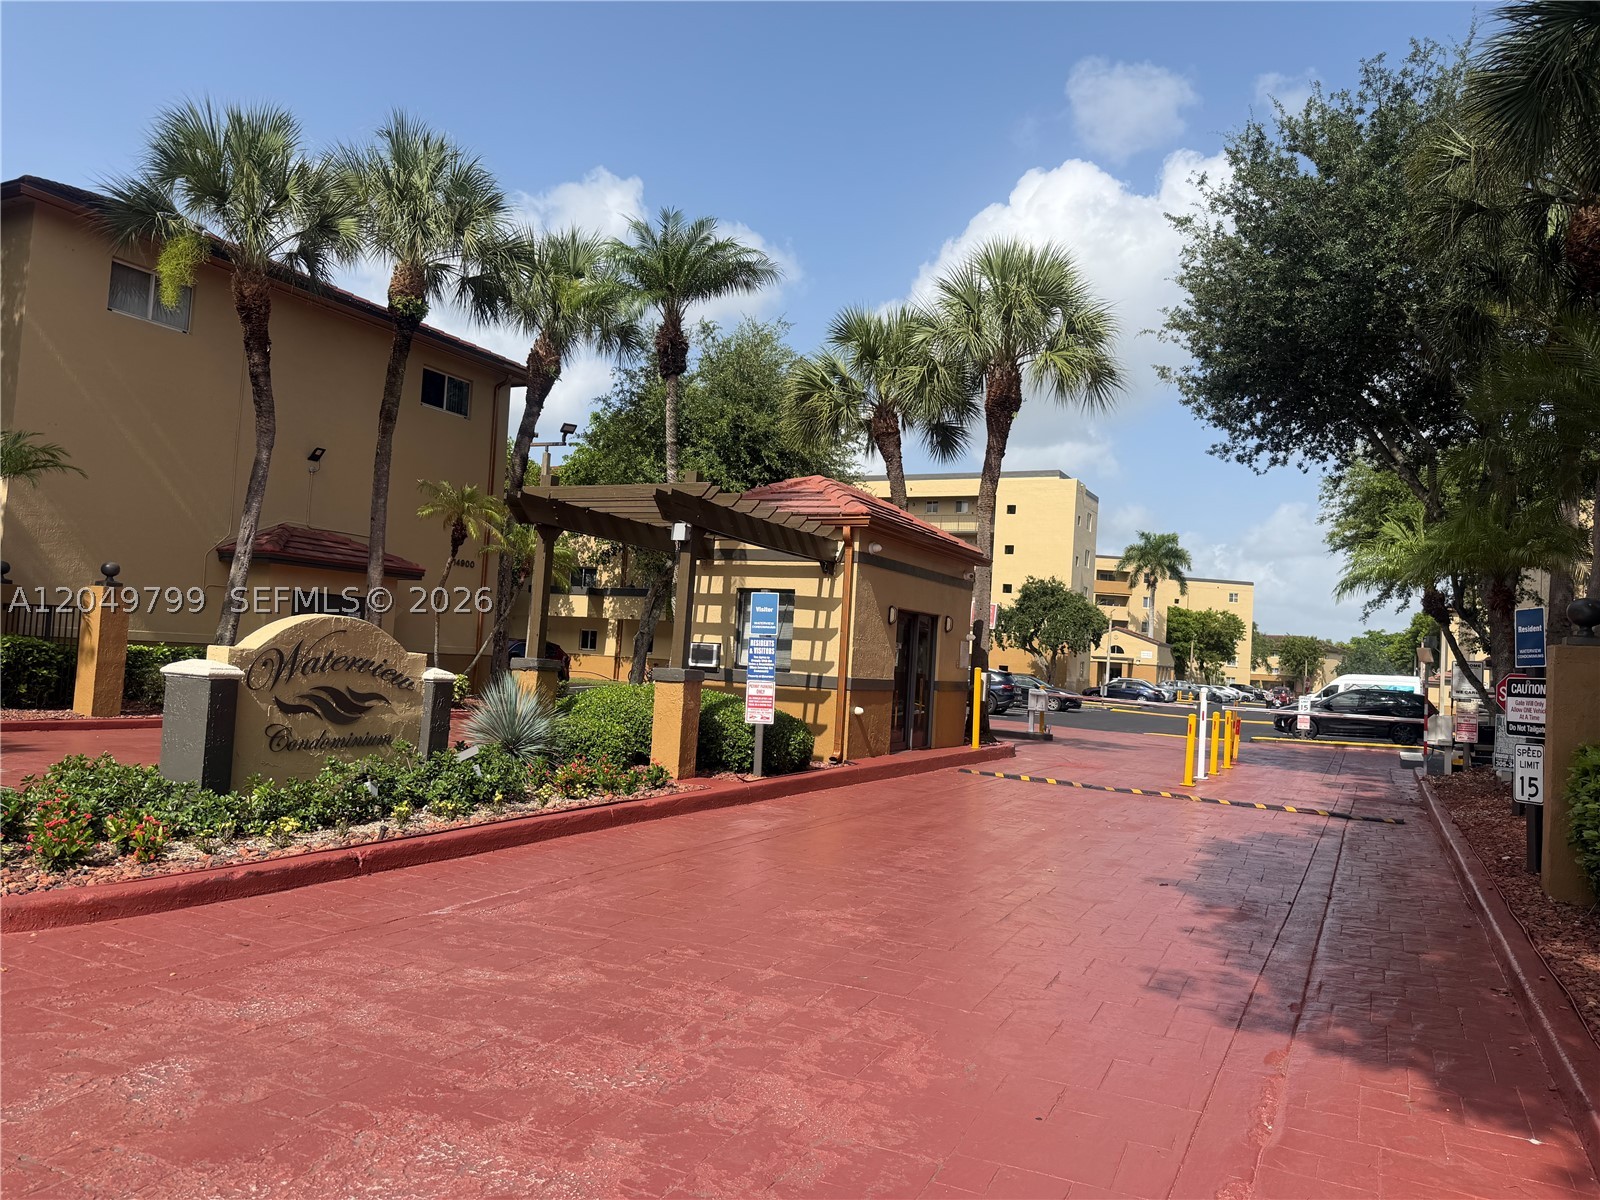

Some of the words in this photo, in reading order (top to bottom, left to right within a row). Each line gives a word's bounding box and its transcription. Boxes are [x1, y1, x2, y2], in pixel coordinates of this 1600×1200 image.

[1517, 625, 1542, 633] Resident
[750, 639, 775, 647] RESIDENTS
[753, 647, 775, 655] VISITORS
[246, 629, 417, 692] Waterview
[1511, 683, 1546, 695] CAUTION
[1534, 700, 1544, 708] Only
[1509, 723, 1516, 731] Do
[1517, 724, 1526, 732] Not
[265, 723, 392, 752] Condominium
[1516, 748, 1543, 758] SPEED
[1519, 761, 1540, 770] LIMIT
[1520, 775, 1539, 798] 15
